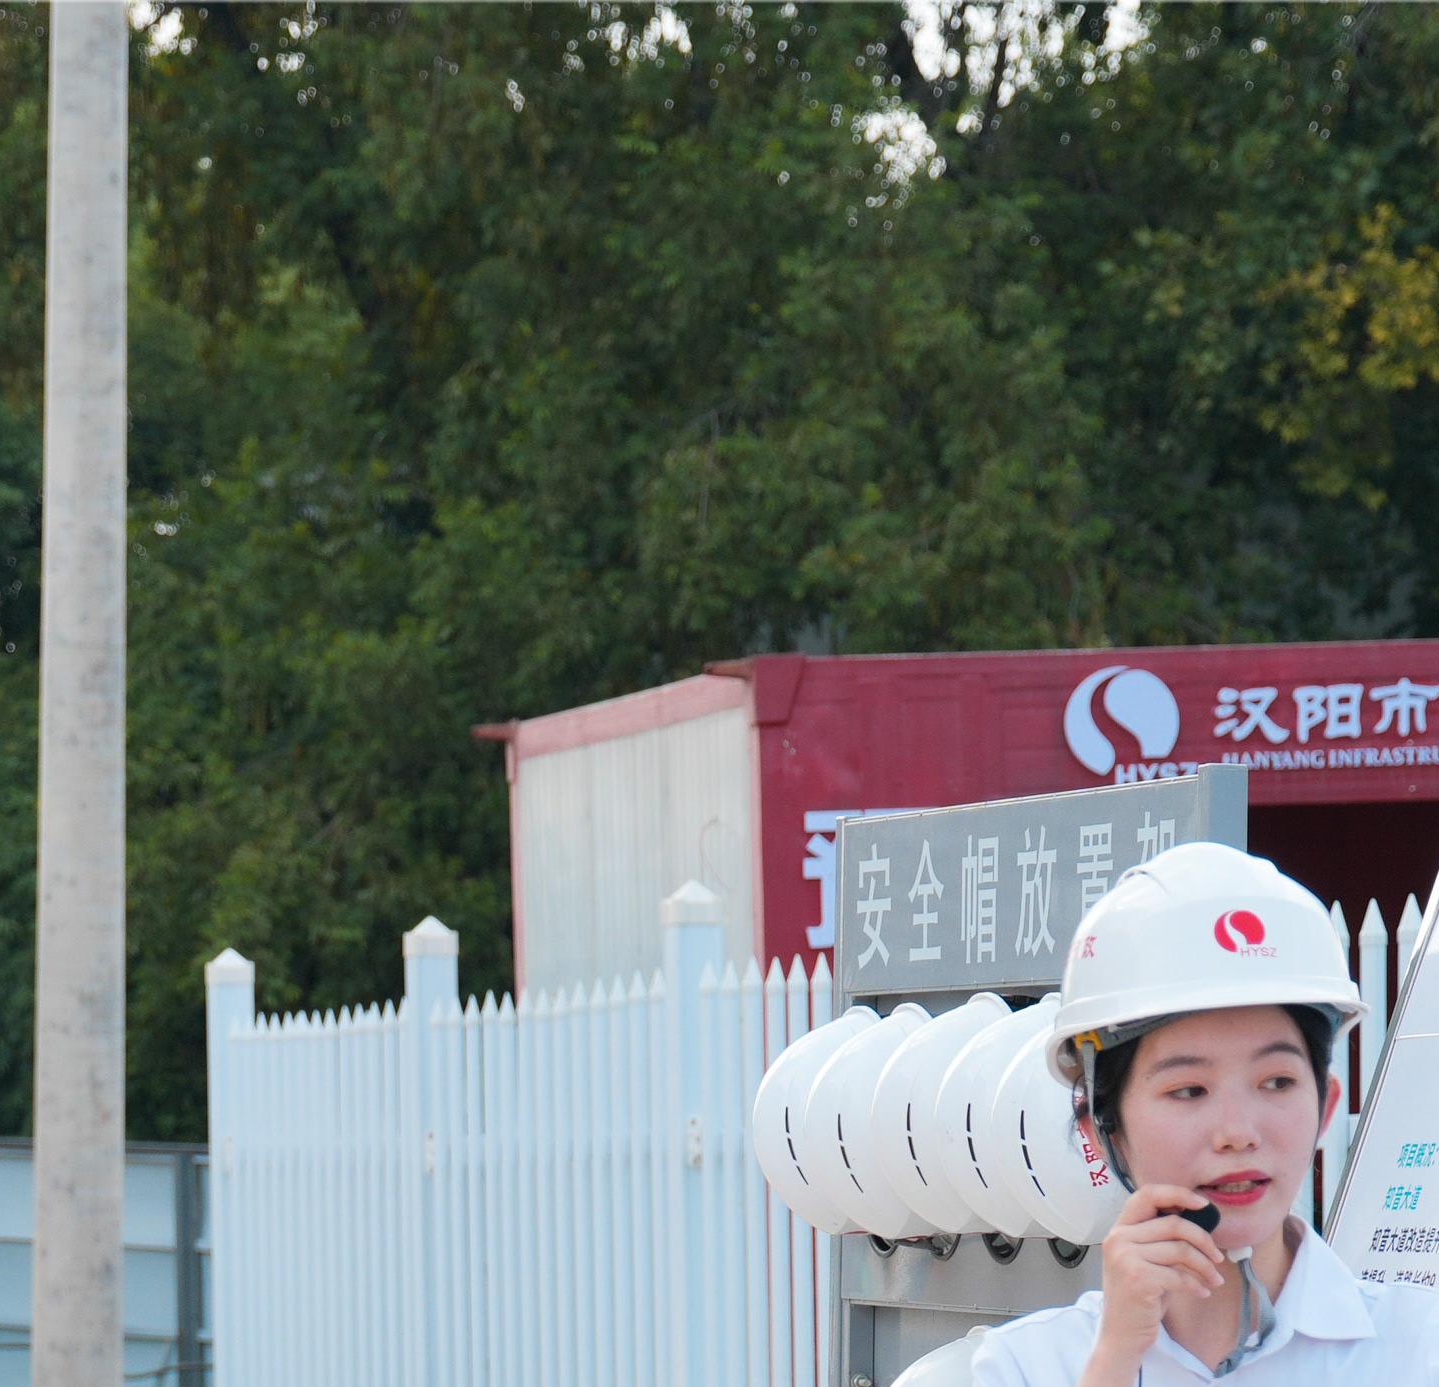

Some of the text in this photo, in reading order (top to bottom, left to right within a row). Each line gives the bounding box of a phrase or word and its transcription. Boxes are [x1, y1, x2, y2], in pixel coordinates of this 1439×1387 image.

[1240, 947, 1278, 958] HYSZ
[1382, 1184, 1423, 1211] 知音大道
